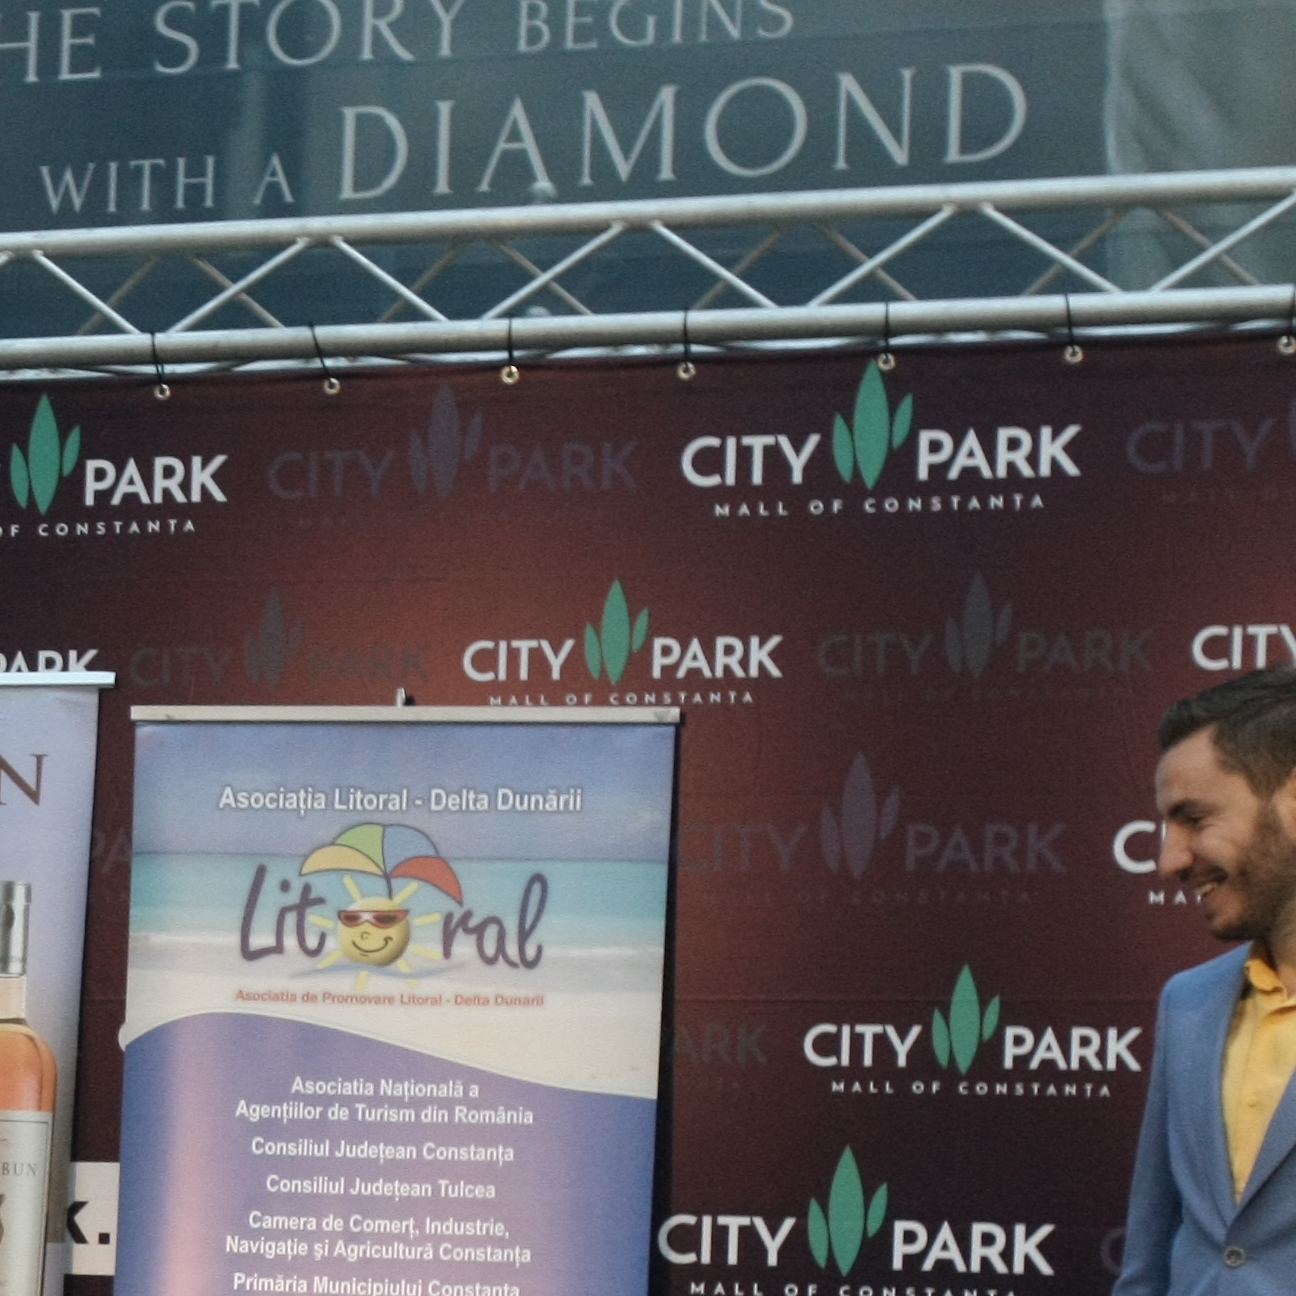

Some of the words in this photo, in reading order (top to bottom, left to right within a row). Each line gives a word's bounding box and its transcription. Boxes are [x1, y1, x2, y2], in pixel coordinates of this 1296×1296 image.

[154, 0, 465, 75] STORY
[518, 0, 796, 54] BEGINS
[39, 155, 215, 214] WITH
[253, 152, 295, 205] A
[339, 62, 1028, 201] DIAMOND
[681, 433, 822, 488] CITY
[916, 424, 1083, 481] PARK
[83, 454, 229, 506] PARK
[715, 502, 789, 517] MALL
[809, 499, 845, 515] OF
[463, 639, 575, 682] CITY
[652, 635, 783, 680] PARK
[490, 695, 549, 707] MALL
[565, 692, 593, 705] OF
[333, 787, 409, 812] Litoral
[430, 788, 491, 813] Delta
[497, 787, 583, 813] Dunării
[301, 989, 319, 1004] de
[322, 990, 396, 1005] Promovare
[400, 991, 443, 1006] Litoral
[454, 992, 491, 1006] Delta
[802, 1022, 924, 1068] CITY
[1004, 1025, 1143, 1072] PARK
[469, 1084, 480, 1099] a
[831, 1080, 895, 1094] MALL
[912, 1080, 941, 1094] OF
[327, 1103, 349, 1121] de
[355, 1103, 415, 1124] Turism
[421, 1105, 449, 1124] din
[455, 1105, 534, 1126] România
[251, 1136, 330, 1158] Consiliul
[265, 1174, 345, 1196] Consiliul
[438, 1180, 496, 1199] Tulcea
[248, 1210, 316, 1231] Camera
[322, 1214, 344, 1232] de
[657, 1214, 796, 1266] CITY
[892, 1220, 1055, 1276] PARK
[233, 1272, 308, 1294] Primăria
[690, 1282, 765, 1296] MALL
